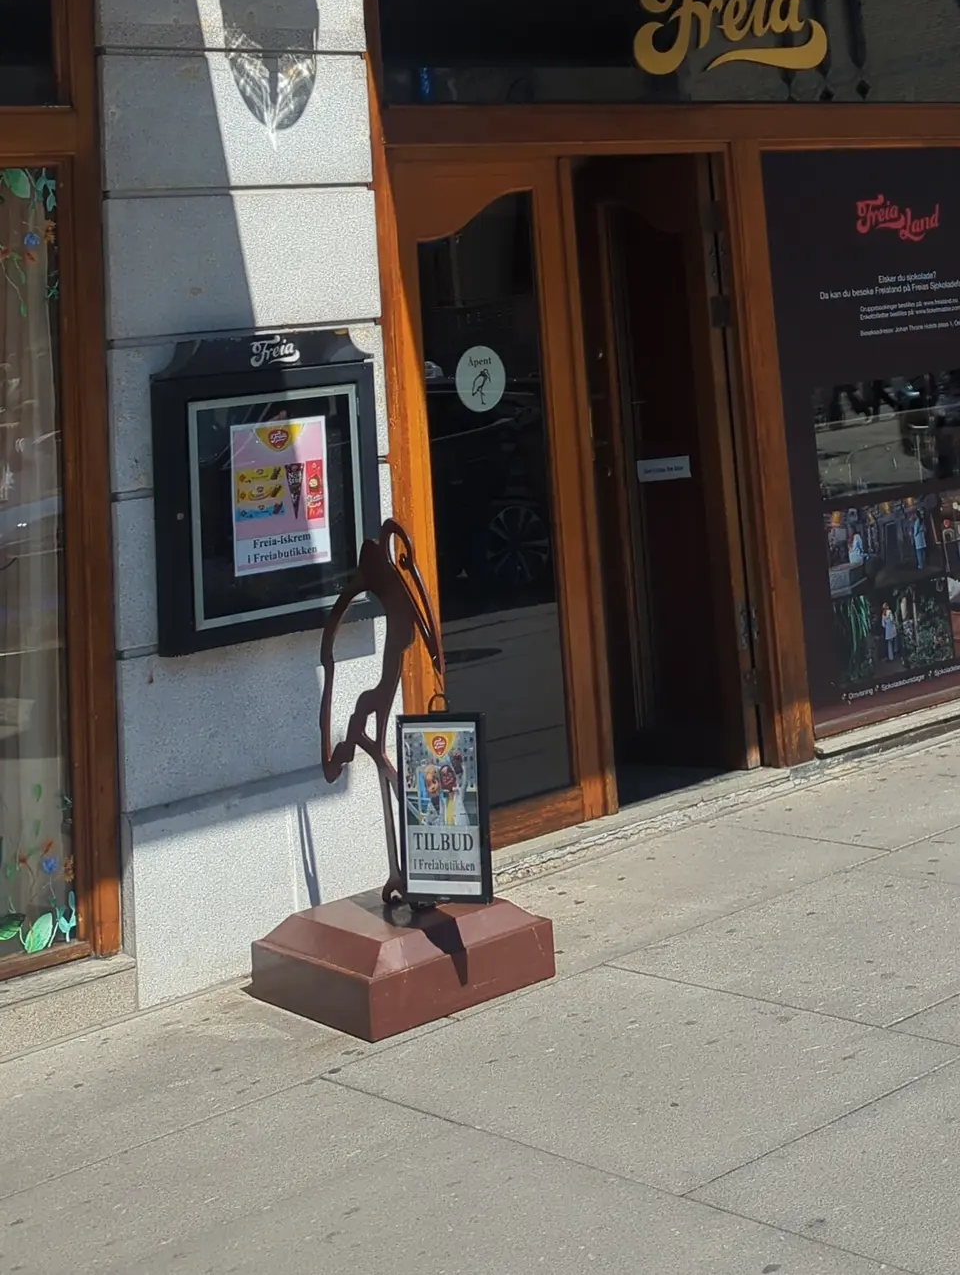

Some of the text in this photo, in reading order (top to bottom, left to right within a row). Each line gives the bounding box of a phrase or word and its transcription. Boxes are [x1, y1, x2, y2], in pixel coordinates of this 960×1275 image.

[856, 193, 905, 234] Freia
[899, 202, 940, 242] Land
[897, 274, 905, 282] du
[819, 291, 829, 300] Da
[829, 290, 841, 299] kan
[842, 289, 851, 298] du
[875, 285, 902, 295] Freialand
[250, 335, 301, 367] Freia
[468, 356, 492, 368] Åpent
[252, 532, 311, 549] Freia-iskrem
[253, 545, 318, 563] Freiabutikken
[413, 833, 474, 851] TILBUD
[418, 858, 476, 872] Freiabutikken
